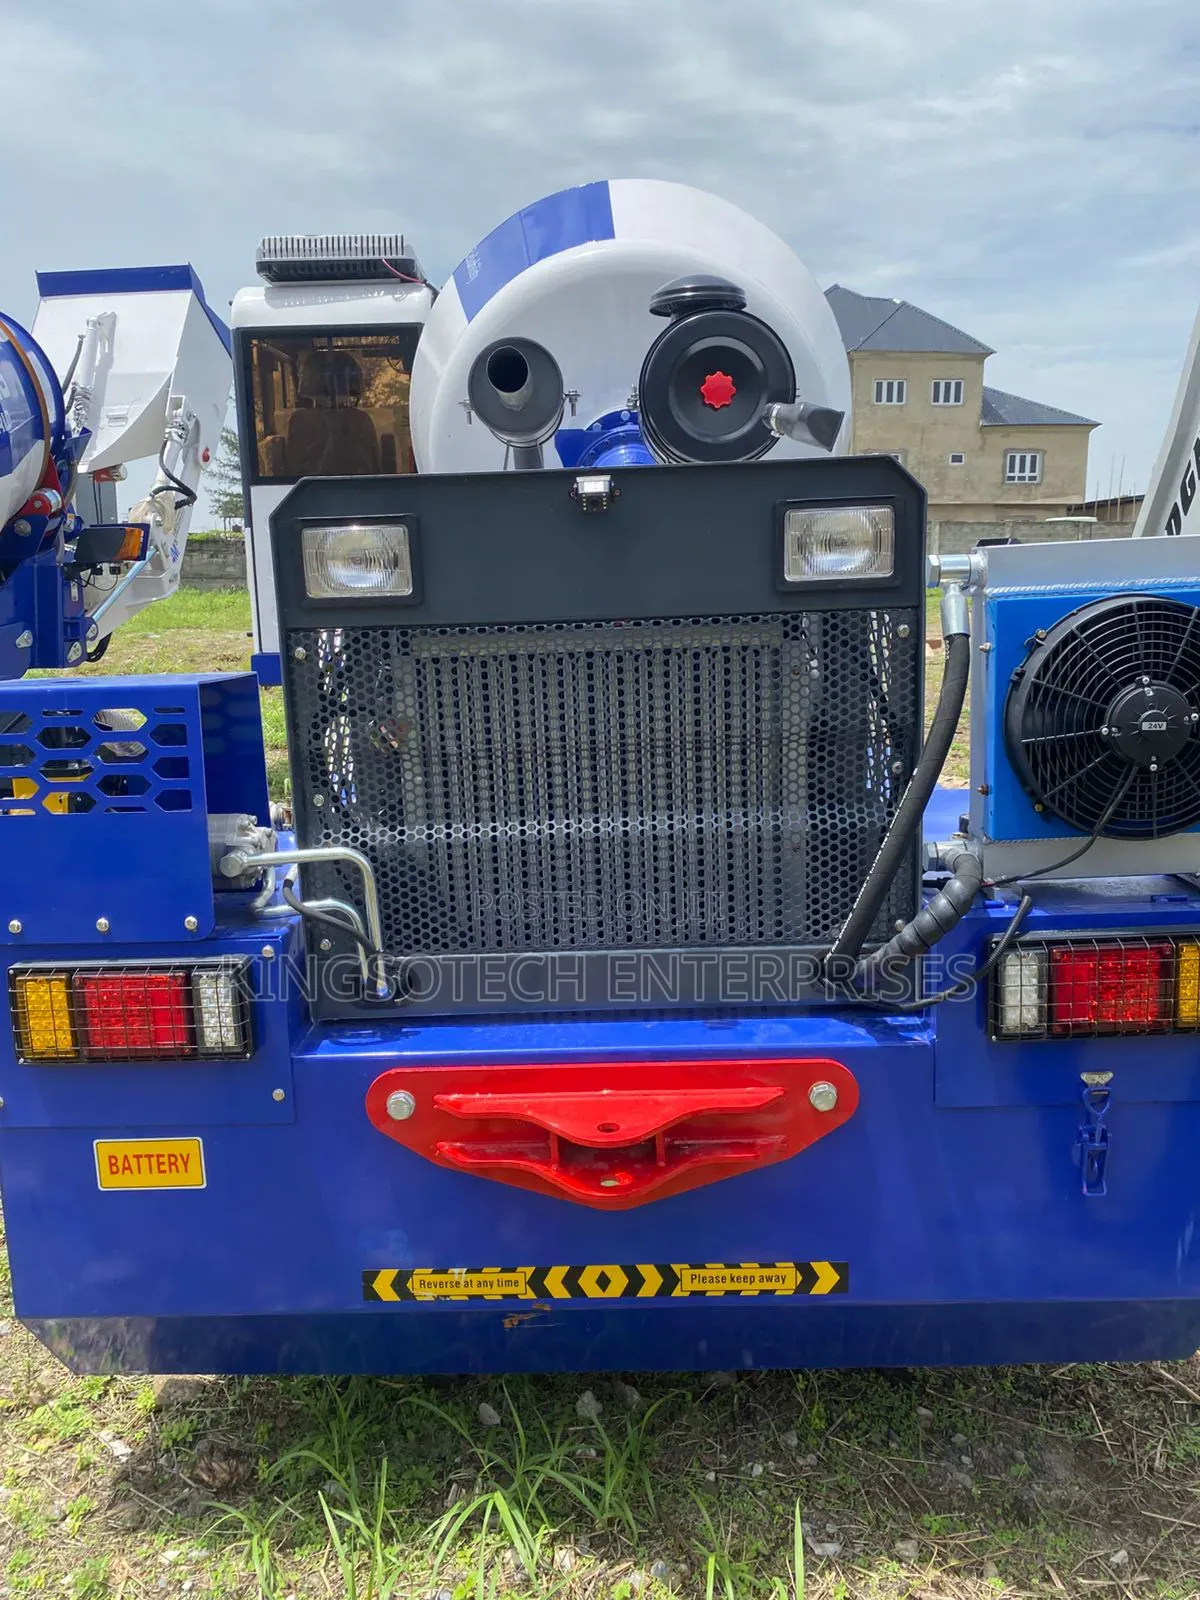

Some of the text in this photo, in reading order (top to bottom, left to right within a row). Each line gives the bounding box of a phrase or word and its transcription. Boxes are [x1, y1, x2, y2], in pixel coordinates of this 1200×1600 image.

[1147, 722, 1164, 730] 24V
[108, 1153, 190, 1175] BATTERY
[419, 1278, 519, 1290] Reverse at any time
[690, 1273, 787, 1285] Please keep away
